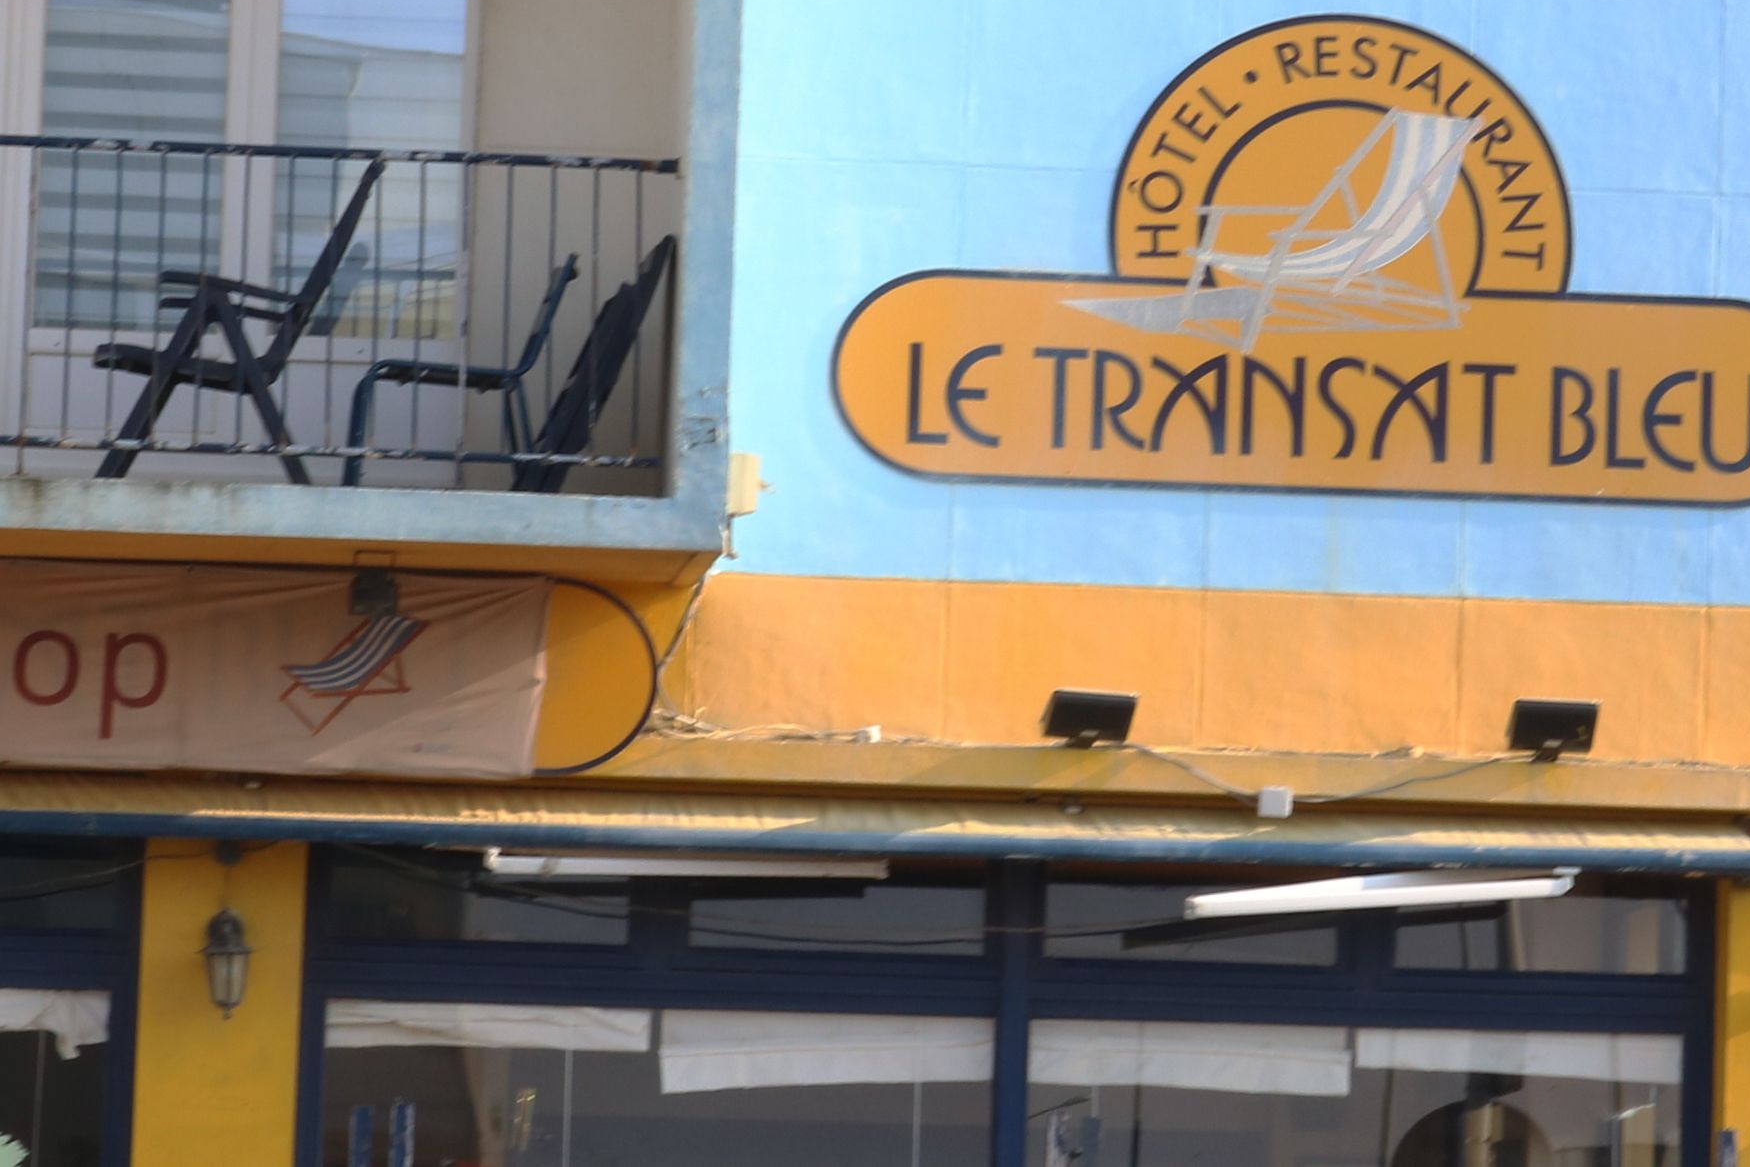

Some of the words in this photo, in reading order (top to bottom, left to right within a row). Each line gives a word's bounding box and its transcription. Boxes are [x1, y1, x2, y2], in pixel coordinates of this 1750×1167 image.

[1128, 84, 1242, 260] HÔTEL
[1273, 35, 1547, 274] RESTAURANT
[906, 342, 1004, 448] LE
[1033, 345, 1517, 466] TRANSAT
[13, 629, 168, 740] op
